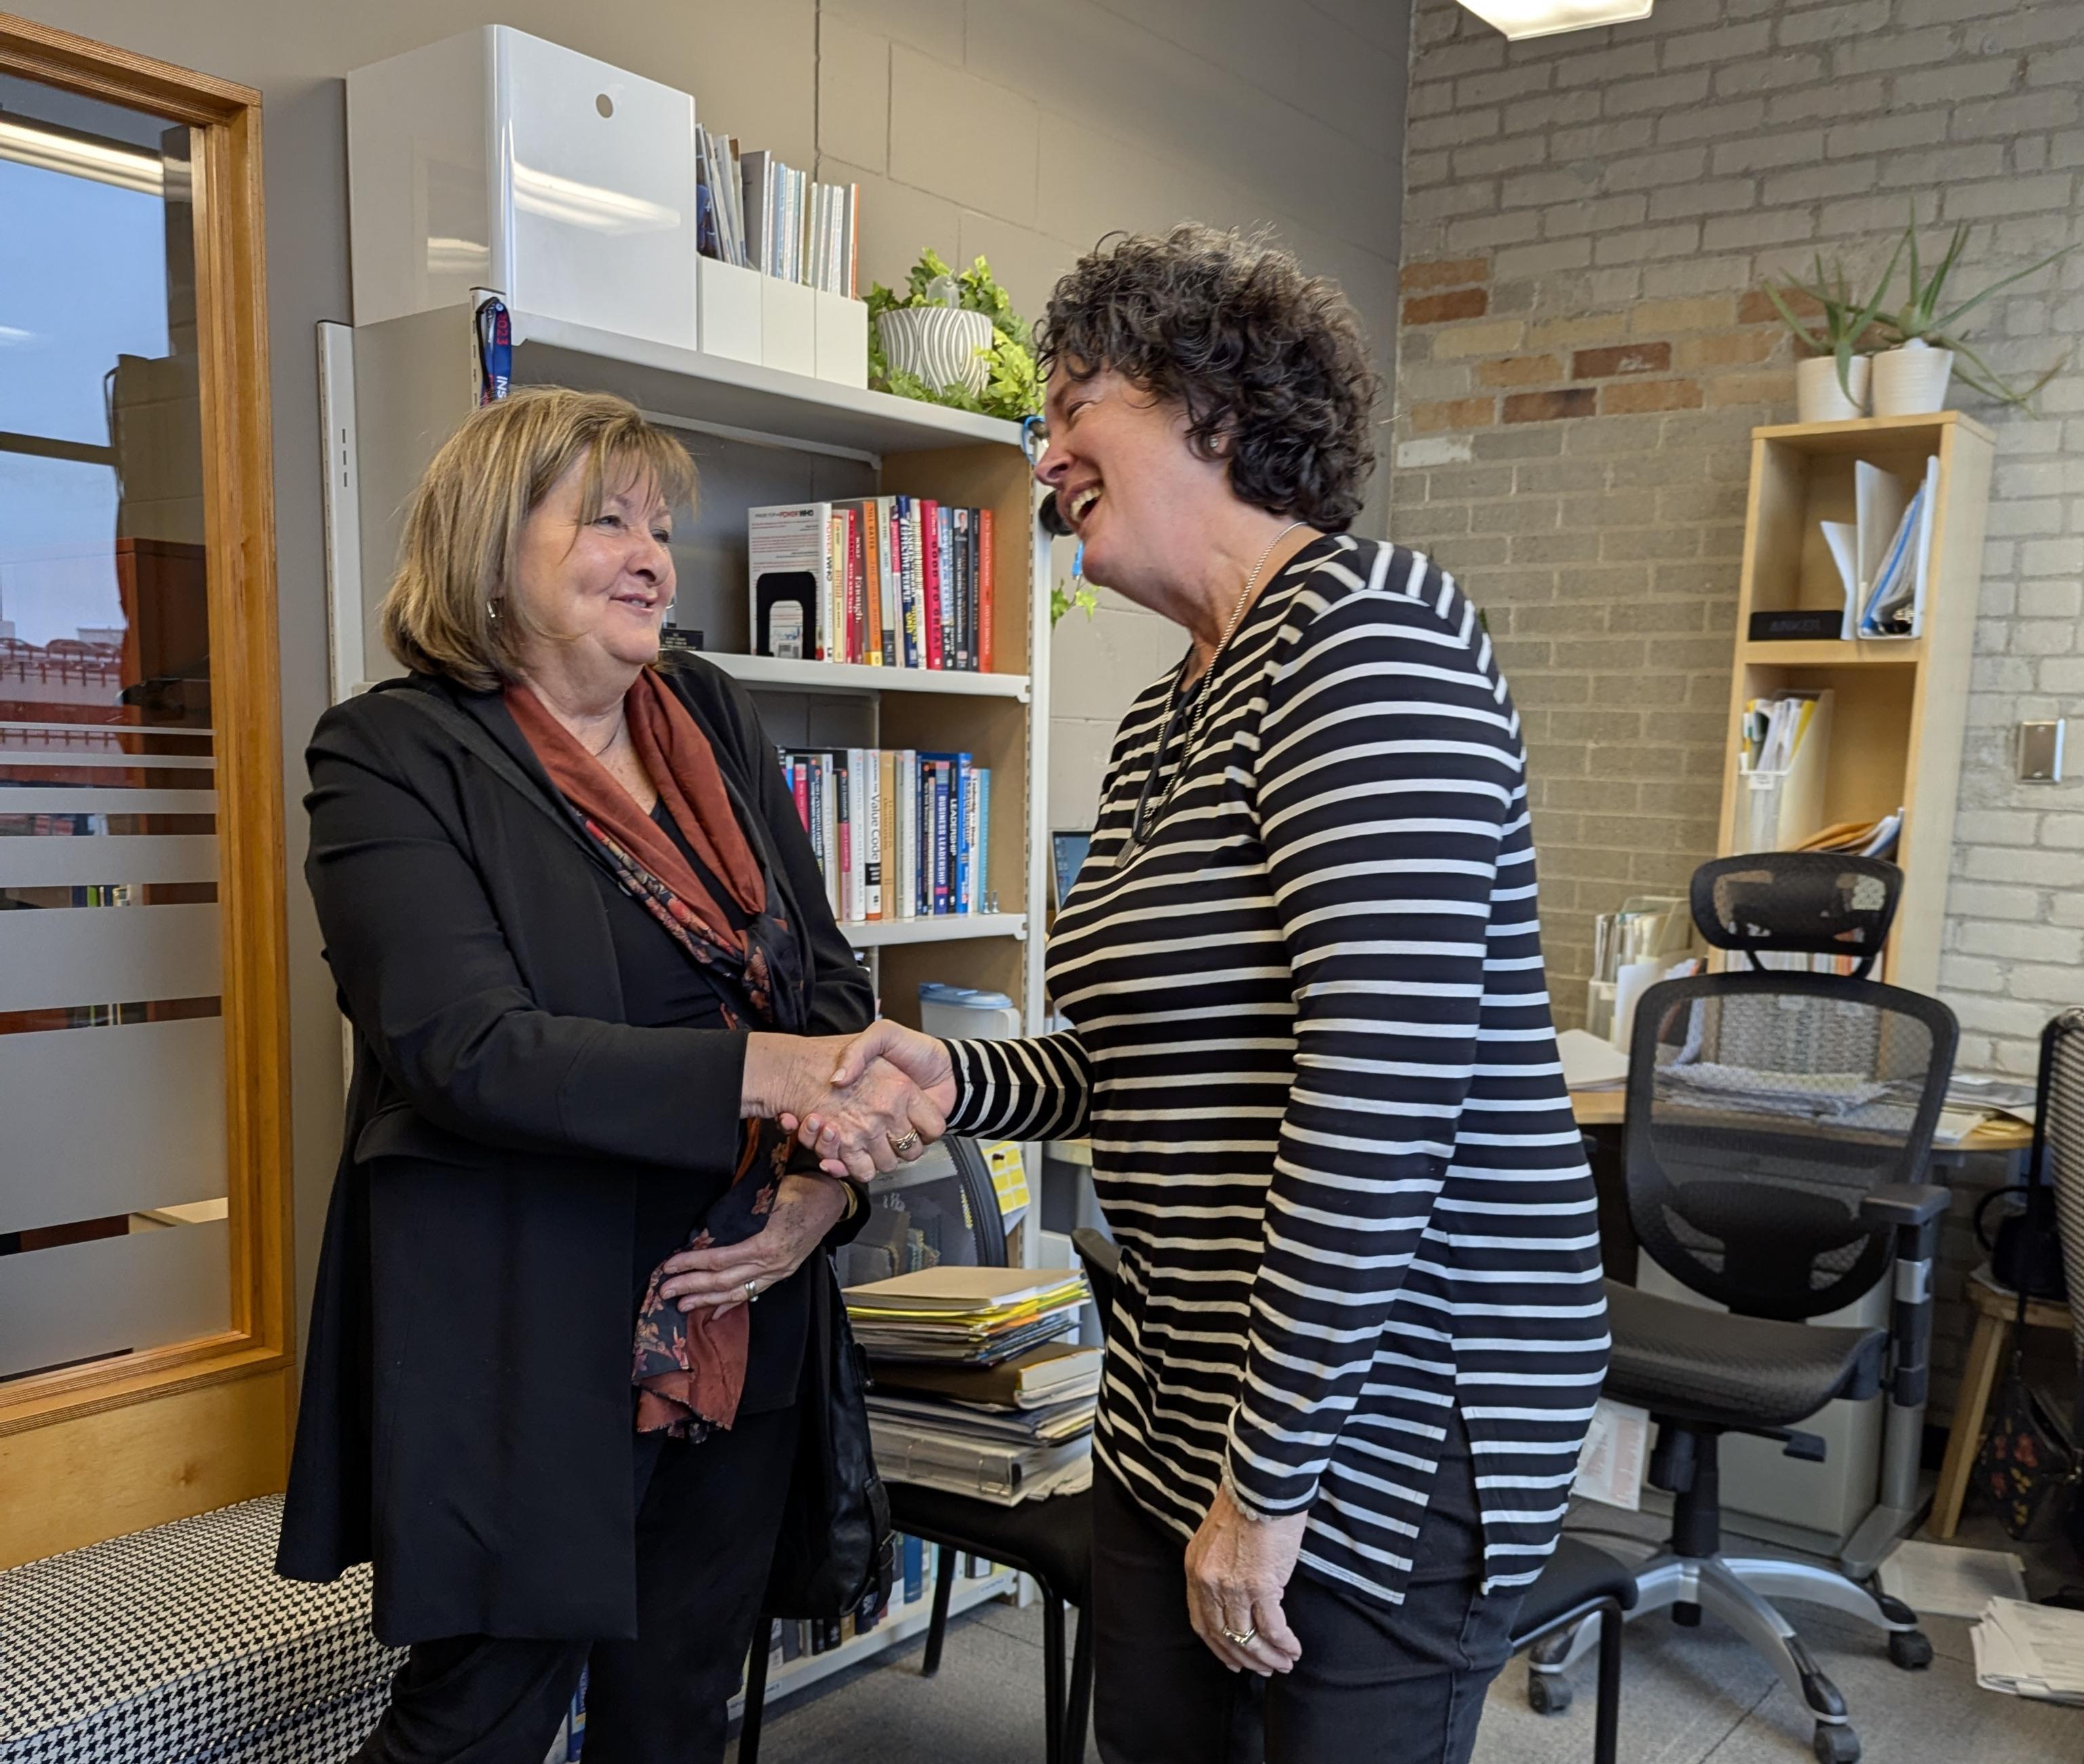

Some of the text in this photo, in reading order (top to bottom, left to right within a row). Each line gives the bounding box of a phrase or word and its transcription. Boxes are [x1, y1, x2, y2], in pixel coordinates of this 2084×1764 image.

[853, 576, 863, 623] Enough.
[933, 586, 939, 602] TO
[871, 794, 880, 826] Value
[871, 829, 880, 860] Code
[938, 795, 947, 885] BUSINESS LEADERSHIP
